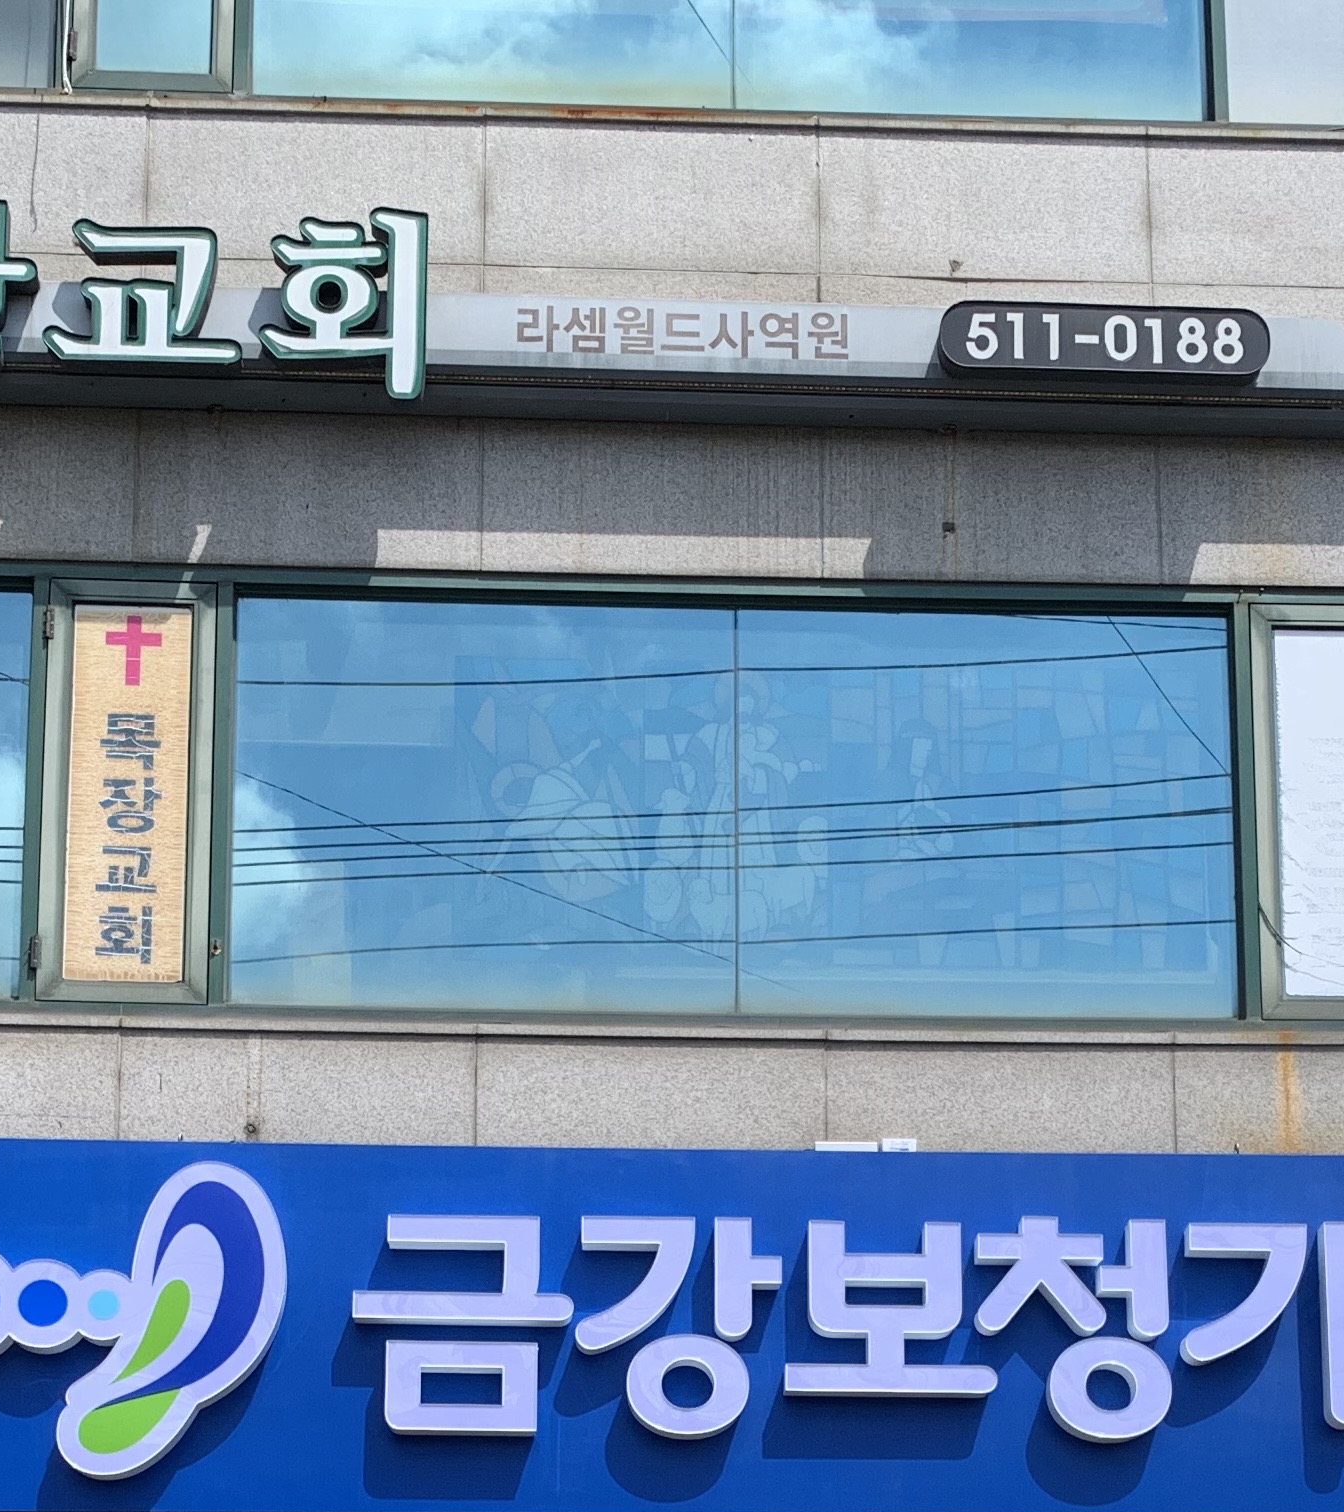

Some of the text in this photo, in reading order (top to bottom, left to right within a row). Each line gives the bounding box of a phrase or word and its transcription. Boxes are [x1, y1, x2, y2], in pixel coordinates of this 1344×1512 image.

[516, 305, 850, 359] 라셈월드사역원
[965, 312, 1244, 364] 511-0188
[95, 713, 163, 964] 목장교회
